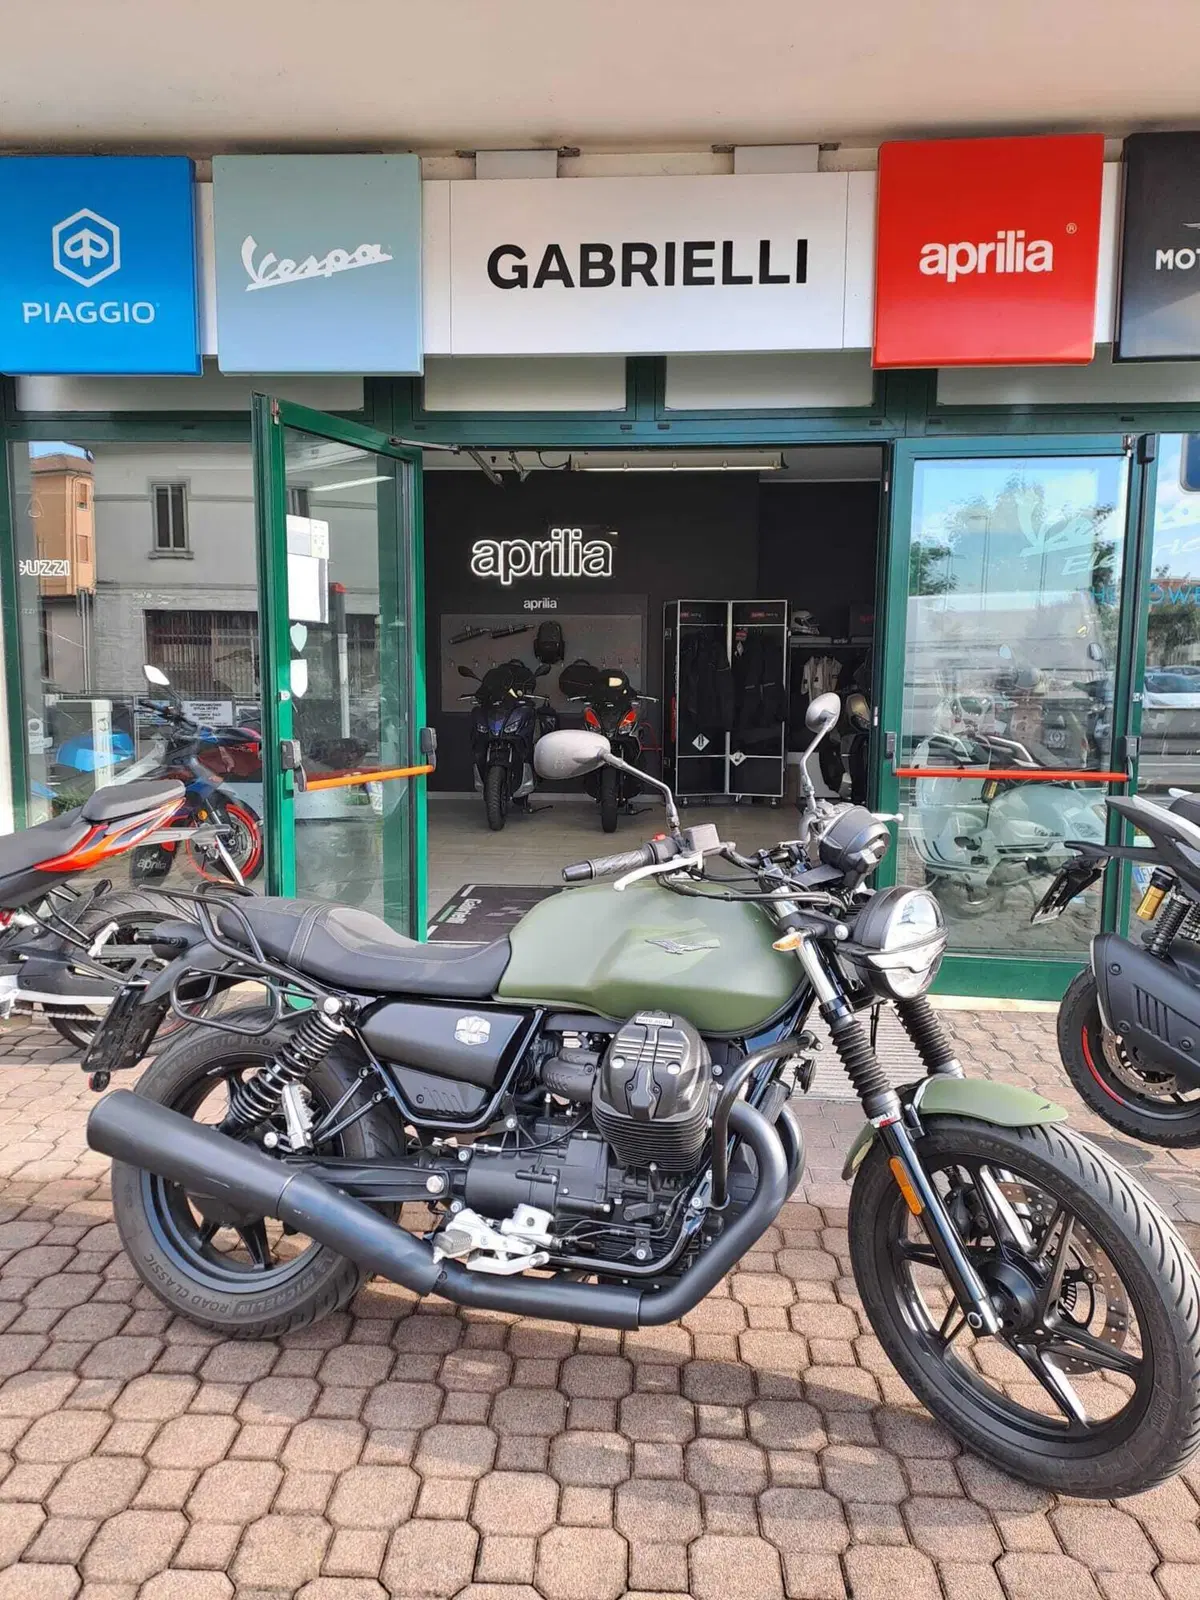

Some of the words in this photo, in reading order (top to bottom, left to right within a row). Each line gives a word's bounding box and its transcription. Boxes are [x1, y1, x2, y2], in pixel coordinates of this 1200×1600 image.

[241, 235, 393, 292] Vespa
[487, 239, 808, 289] GABRIELLI
[919, 229, 1053, 283] aprilia
[22, 301, 156, 324] PIAGGIO
[471, 528, 612, 585] aprilia
[523, 598, 558, 611] aprilia
[143, 1254, 189, 1299] CLASSIC
[191, 1296, 230, 1314] ROAD
